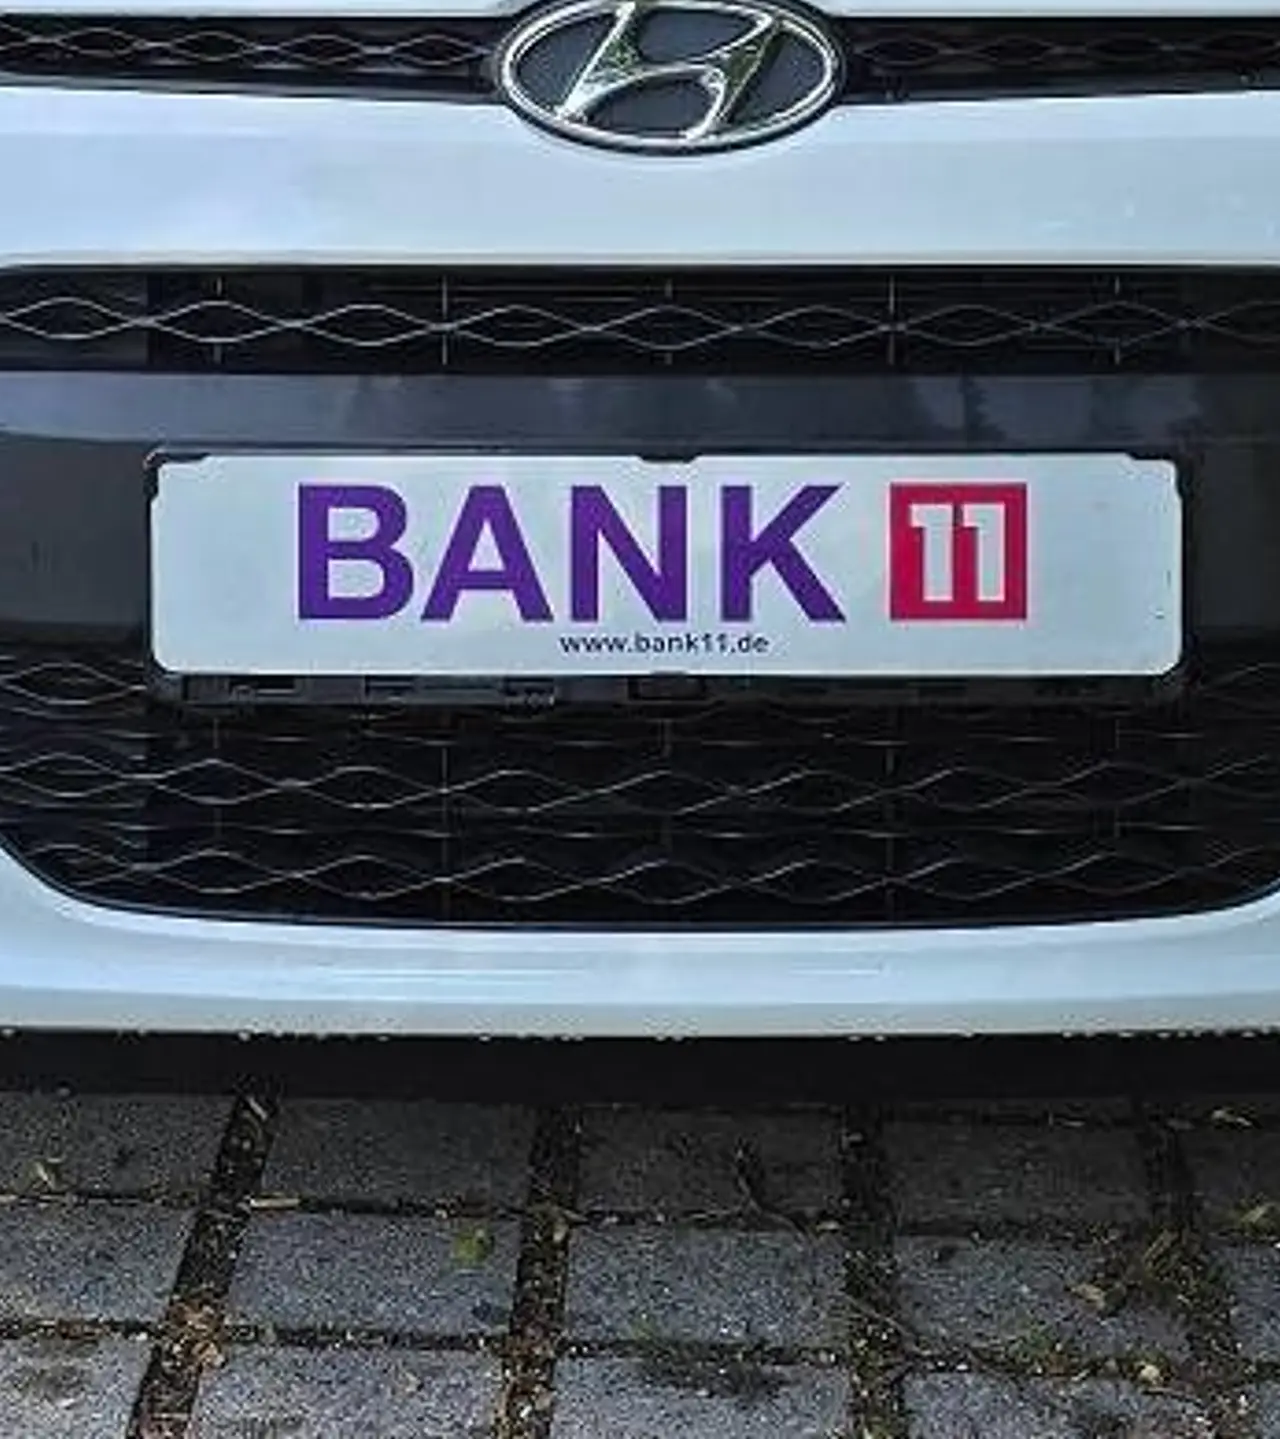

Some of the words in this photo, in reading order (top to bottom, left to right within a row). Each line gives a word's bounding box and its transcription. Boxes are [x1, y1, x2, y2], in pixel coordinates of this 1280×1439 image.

[297, 482, 847, 622] BANK
[907, 501, 1009, 603] 11
[559, 633, 770, 654] www.bank11.de
